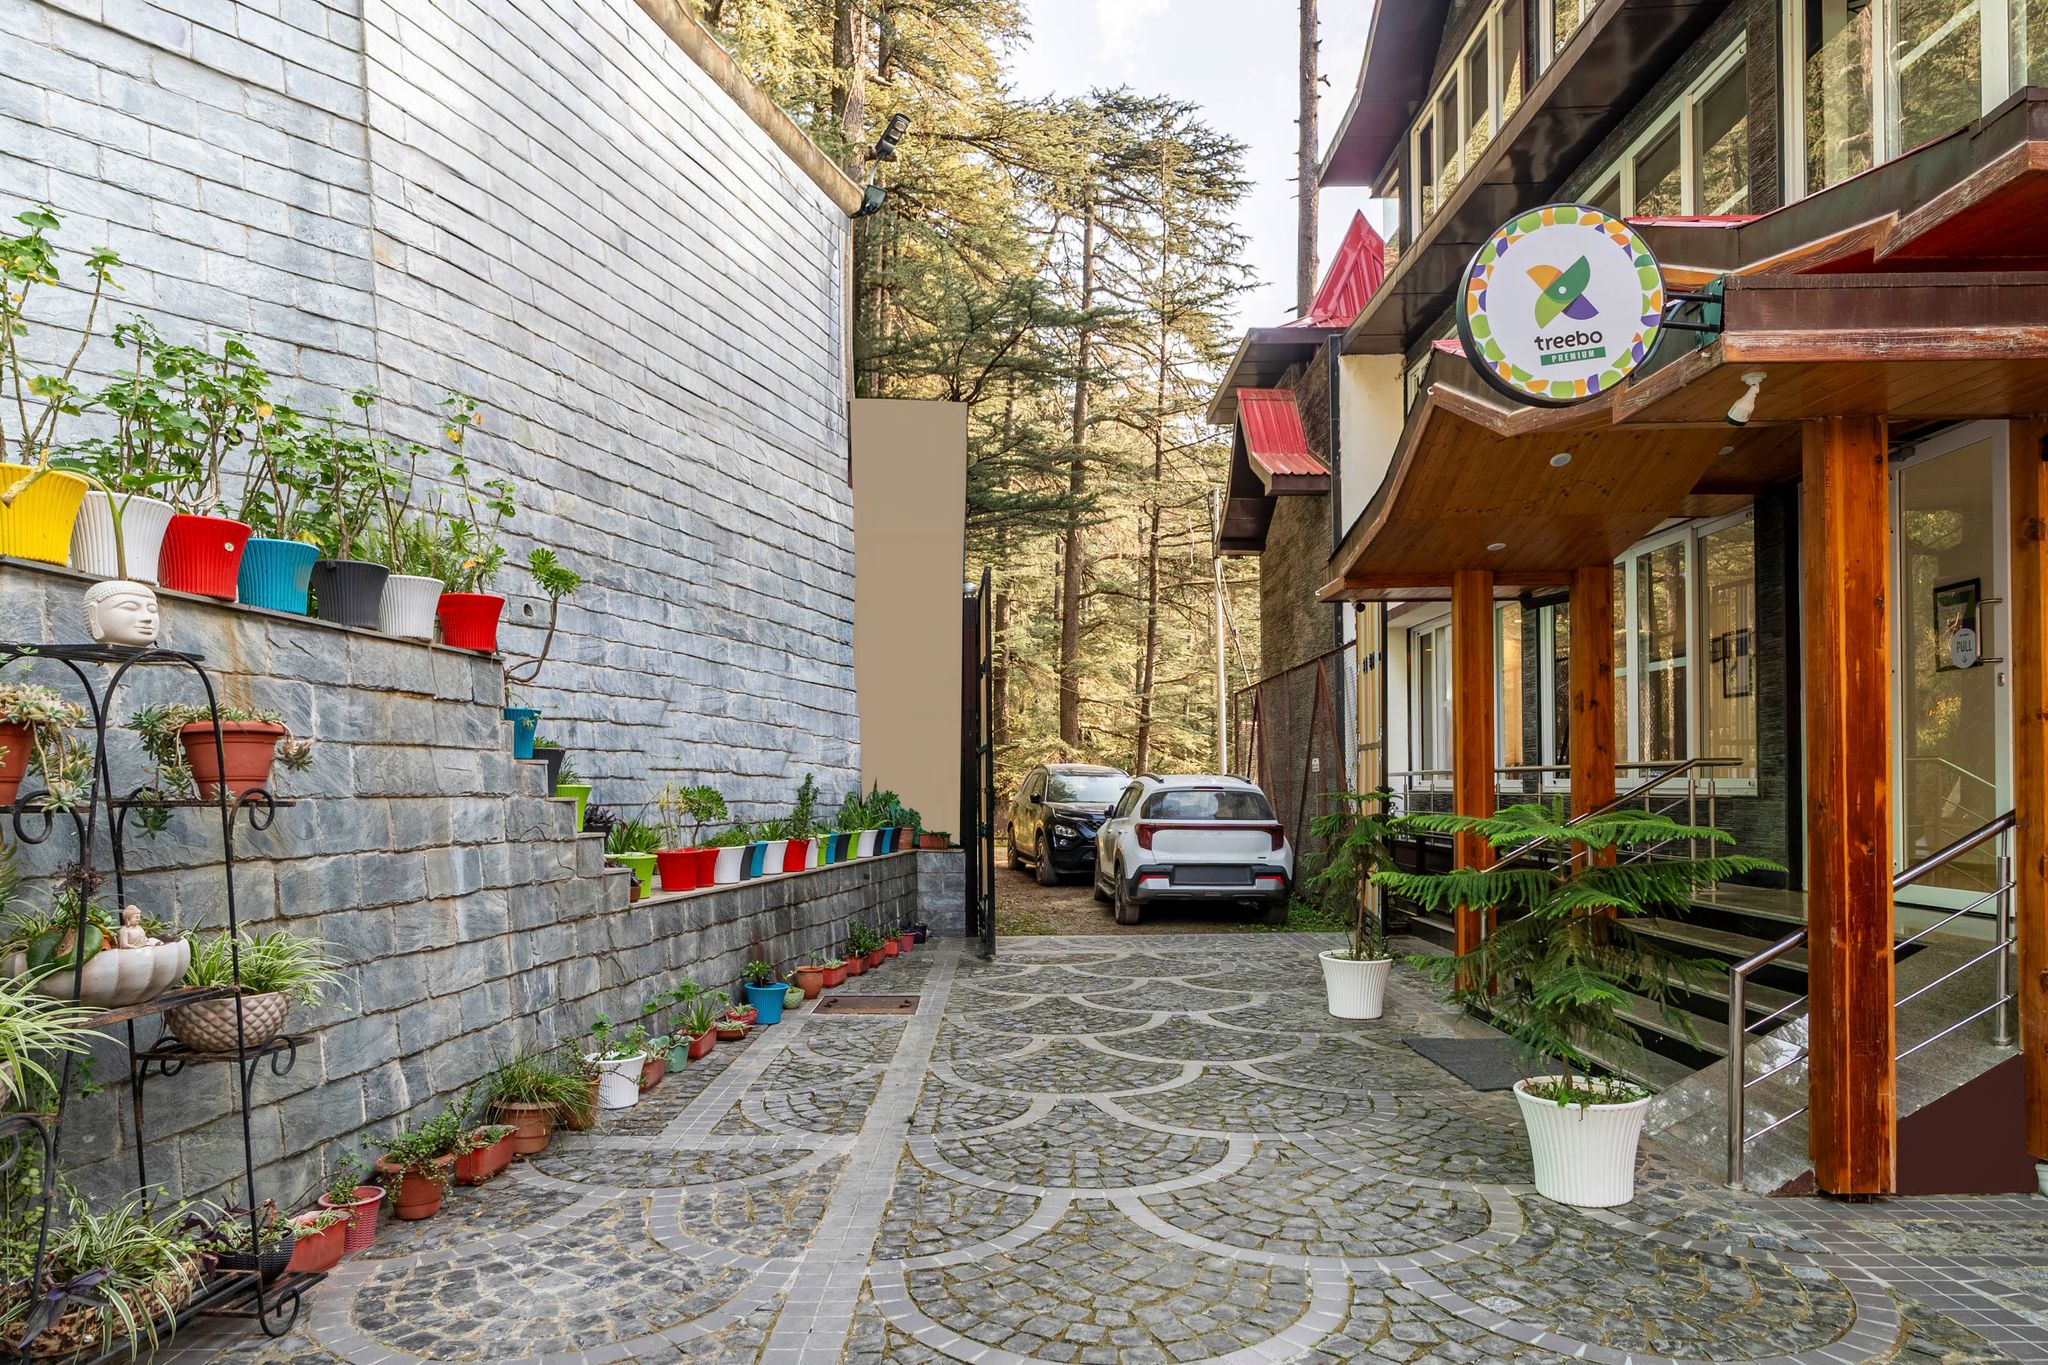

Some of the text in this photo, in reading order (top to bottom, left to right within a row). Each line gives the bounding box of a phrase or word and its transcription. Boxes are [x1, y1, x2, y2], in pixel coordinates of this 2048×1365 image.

[1534, 331, 1603, 351] treebo
[1551, 350, 1595, 363] PREMIUM
[1956, 640, 1973, 653] PULL
